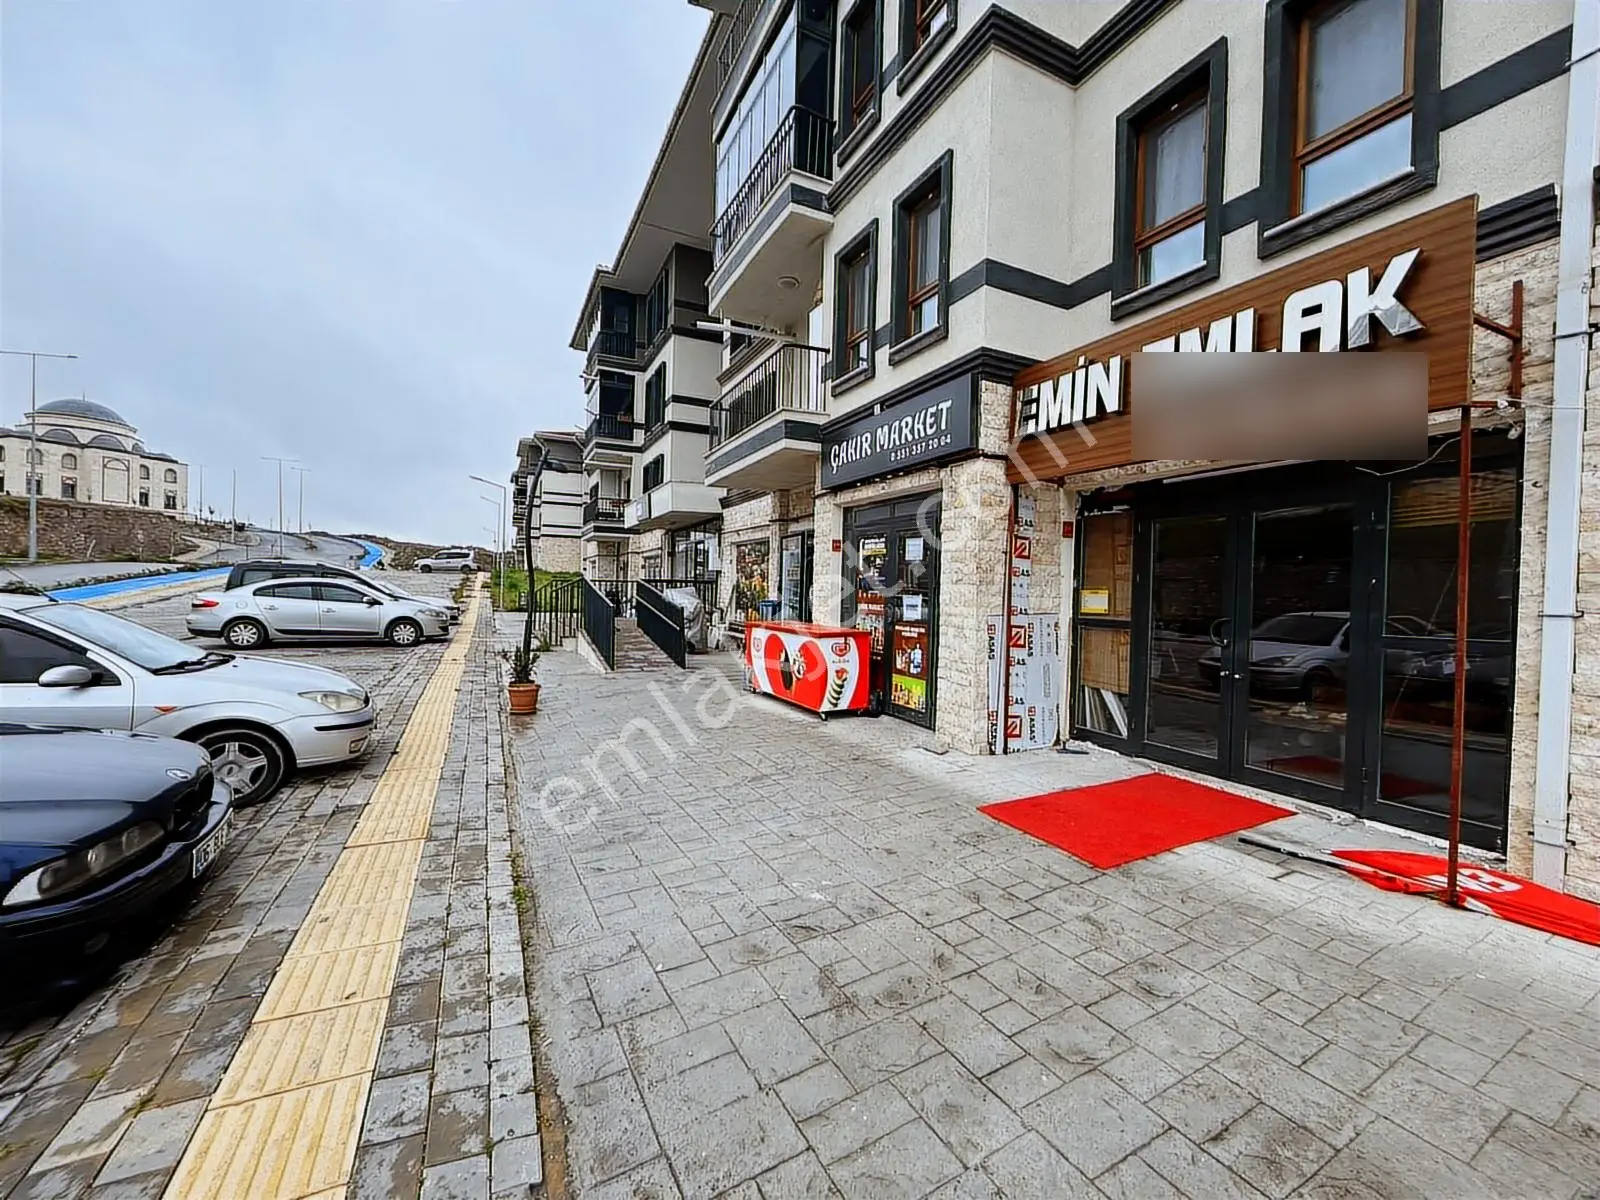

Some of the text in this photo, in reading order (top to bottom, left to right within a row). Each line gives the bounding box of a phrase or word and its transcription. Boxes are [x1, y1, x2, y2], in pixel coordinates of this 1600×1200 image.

[1015, 355, 1122, 437] EMİN
[830, 400, 953, 474] ÇAKIR MARKET
